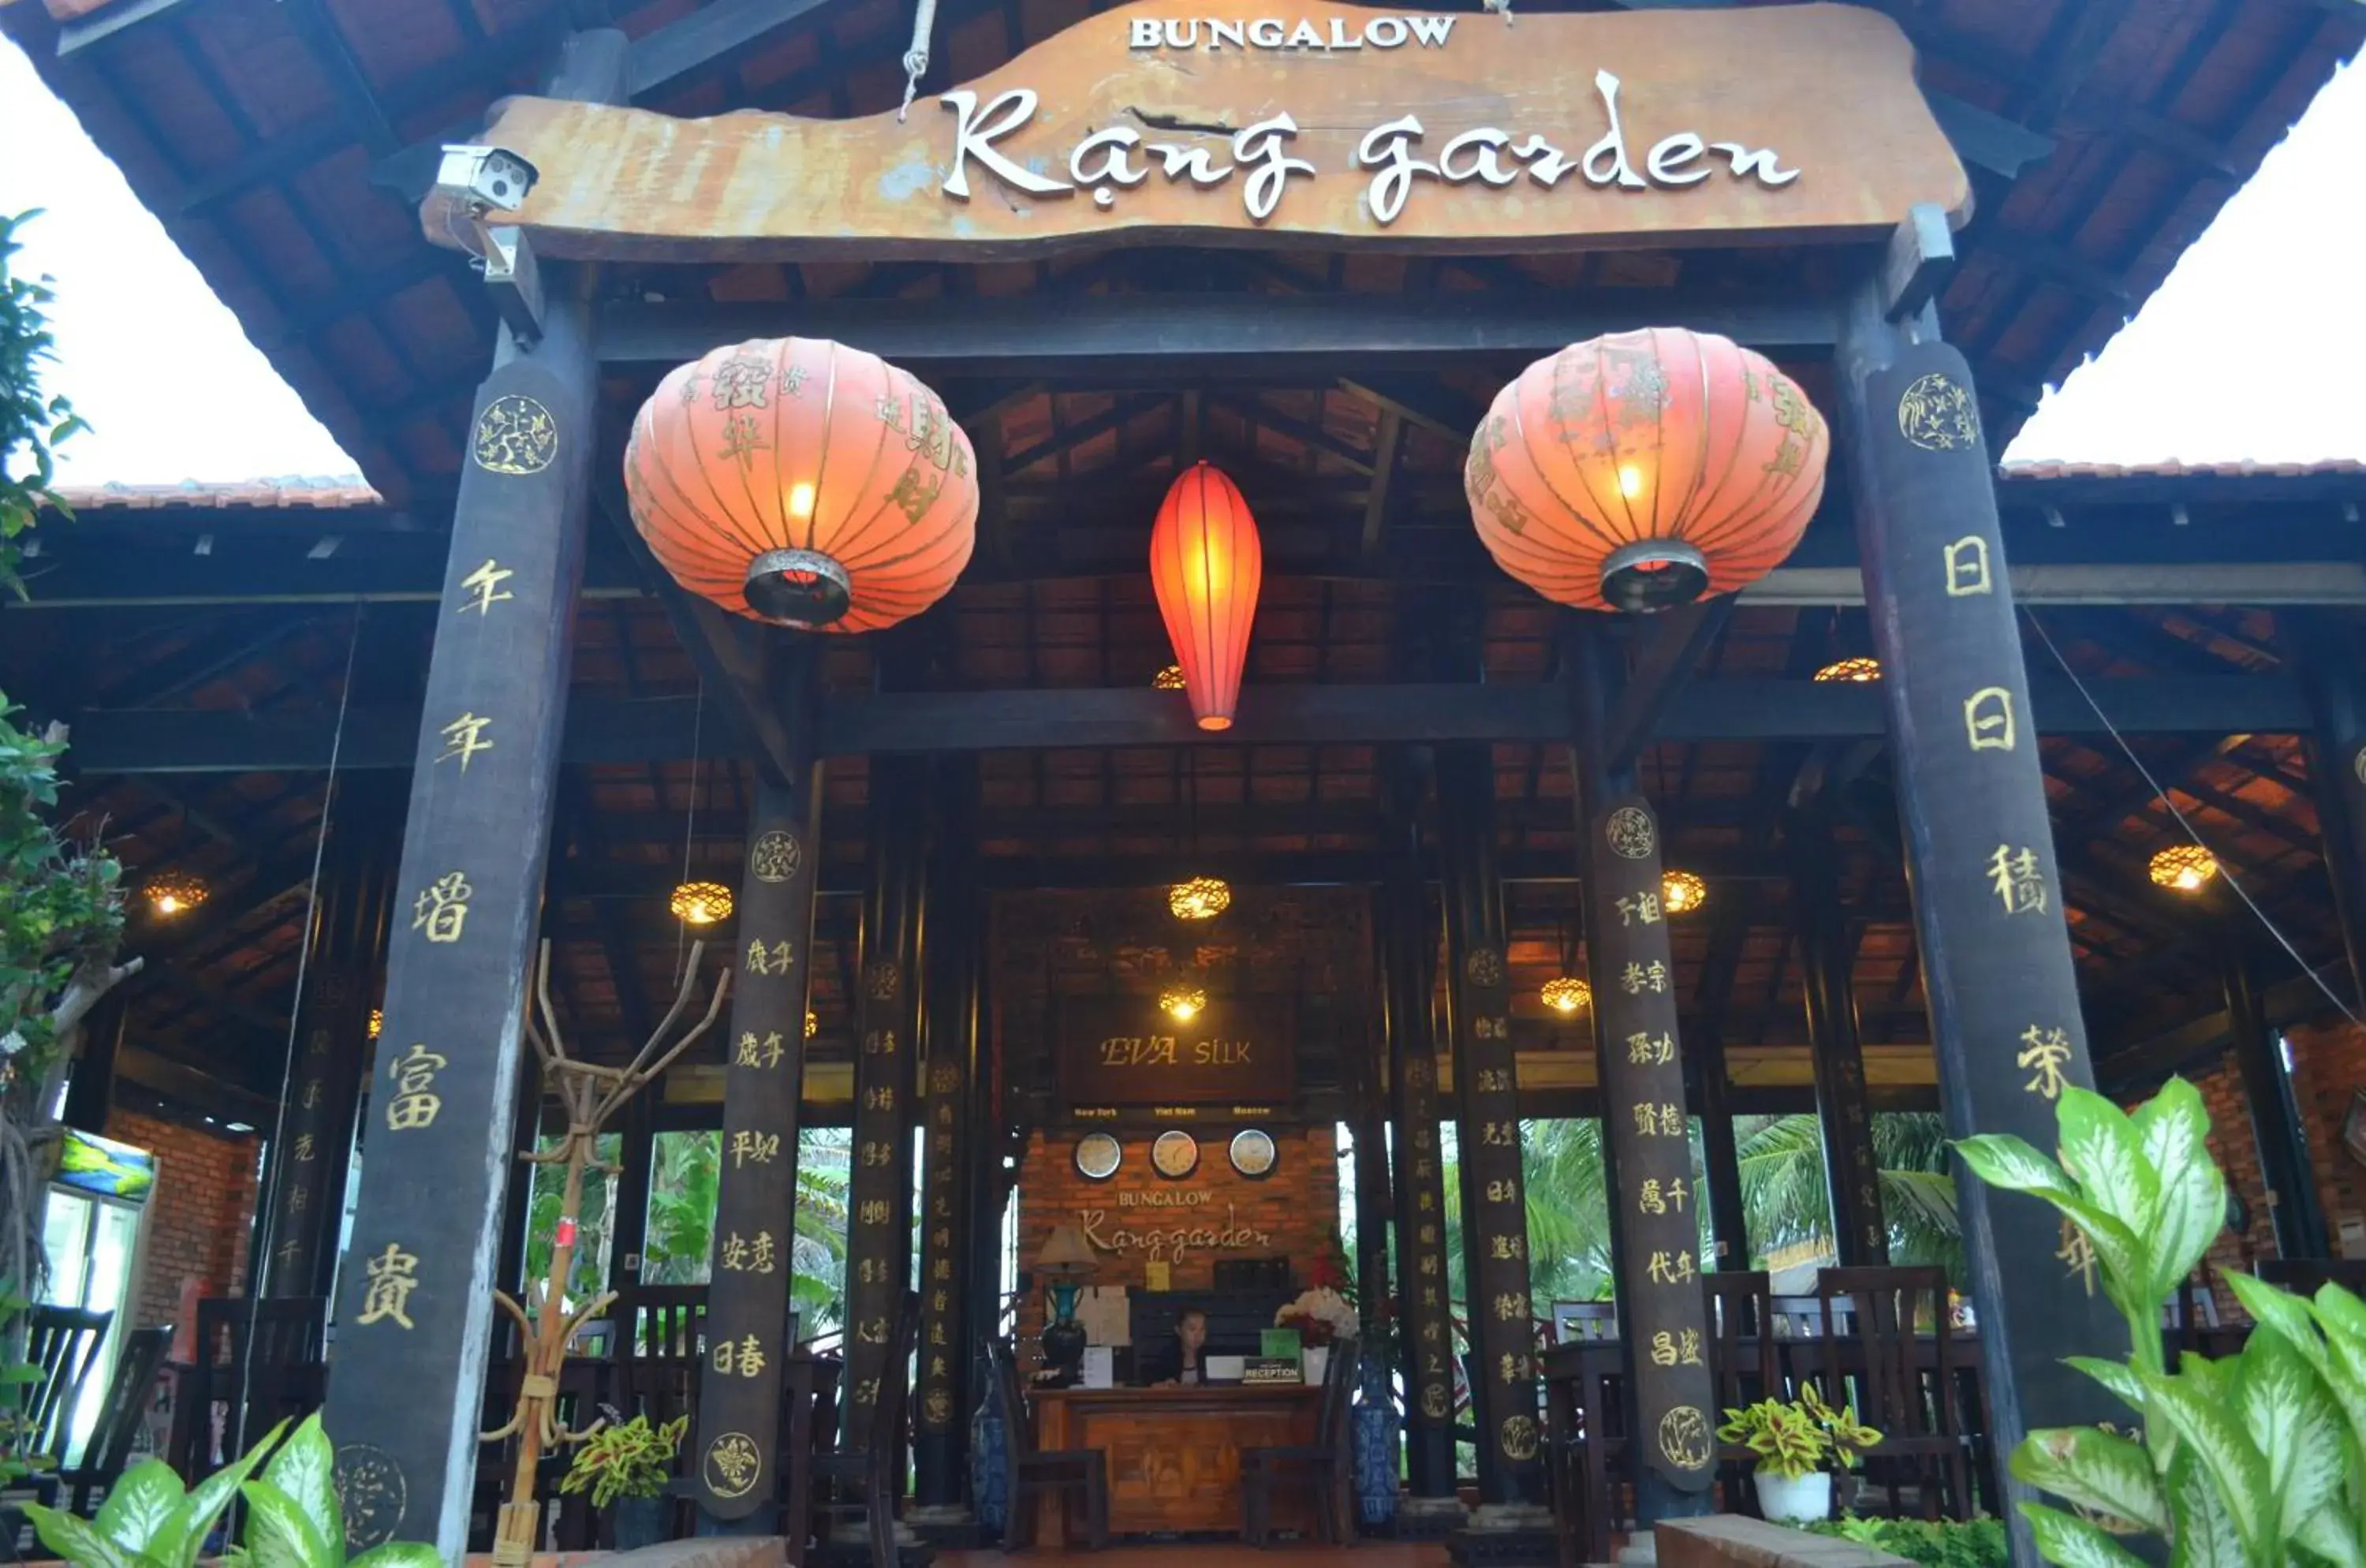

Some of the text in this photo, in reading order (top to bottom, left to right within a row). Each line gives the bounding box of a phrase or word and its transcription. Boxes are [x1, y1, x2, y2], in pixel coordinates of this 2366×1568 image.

[1129, 16, 1457, 50] BUNGALOW
[1358, 68, 1801, 226] garden
[1101, 1035, 1177, 1066] EVA
[1118, 1191, 1214, 1207] BUNGALOW
[1170, 1203, 1271, 1264] garden
[1245, 1367, 1299, 1378] RECEPTION
